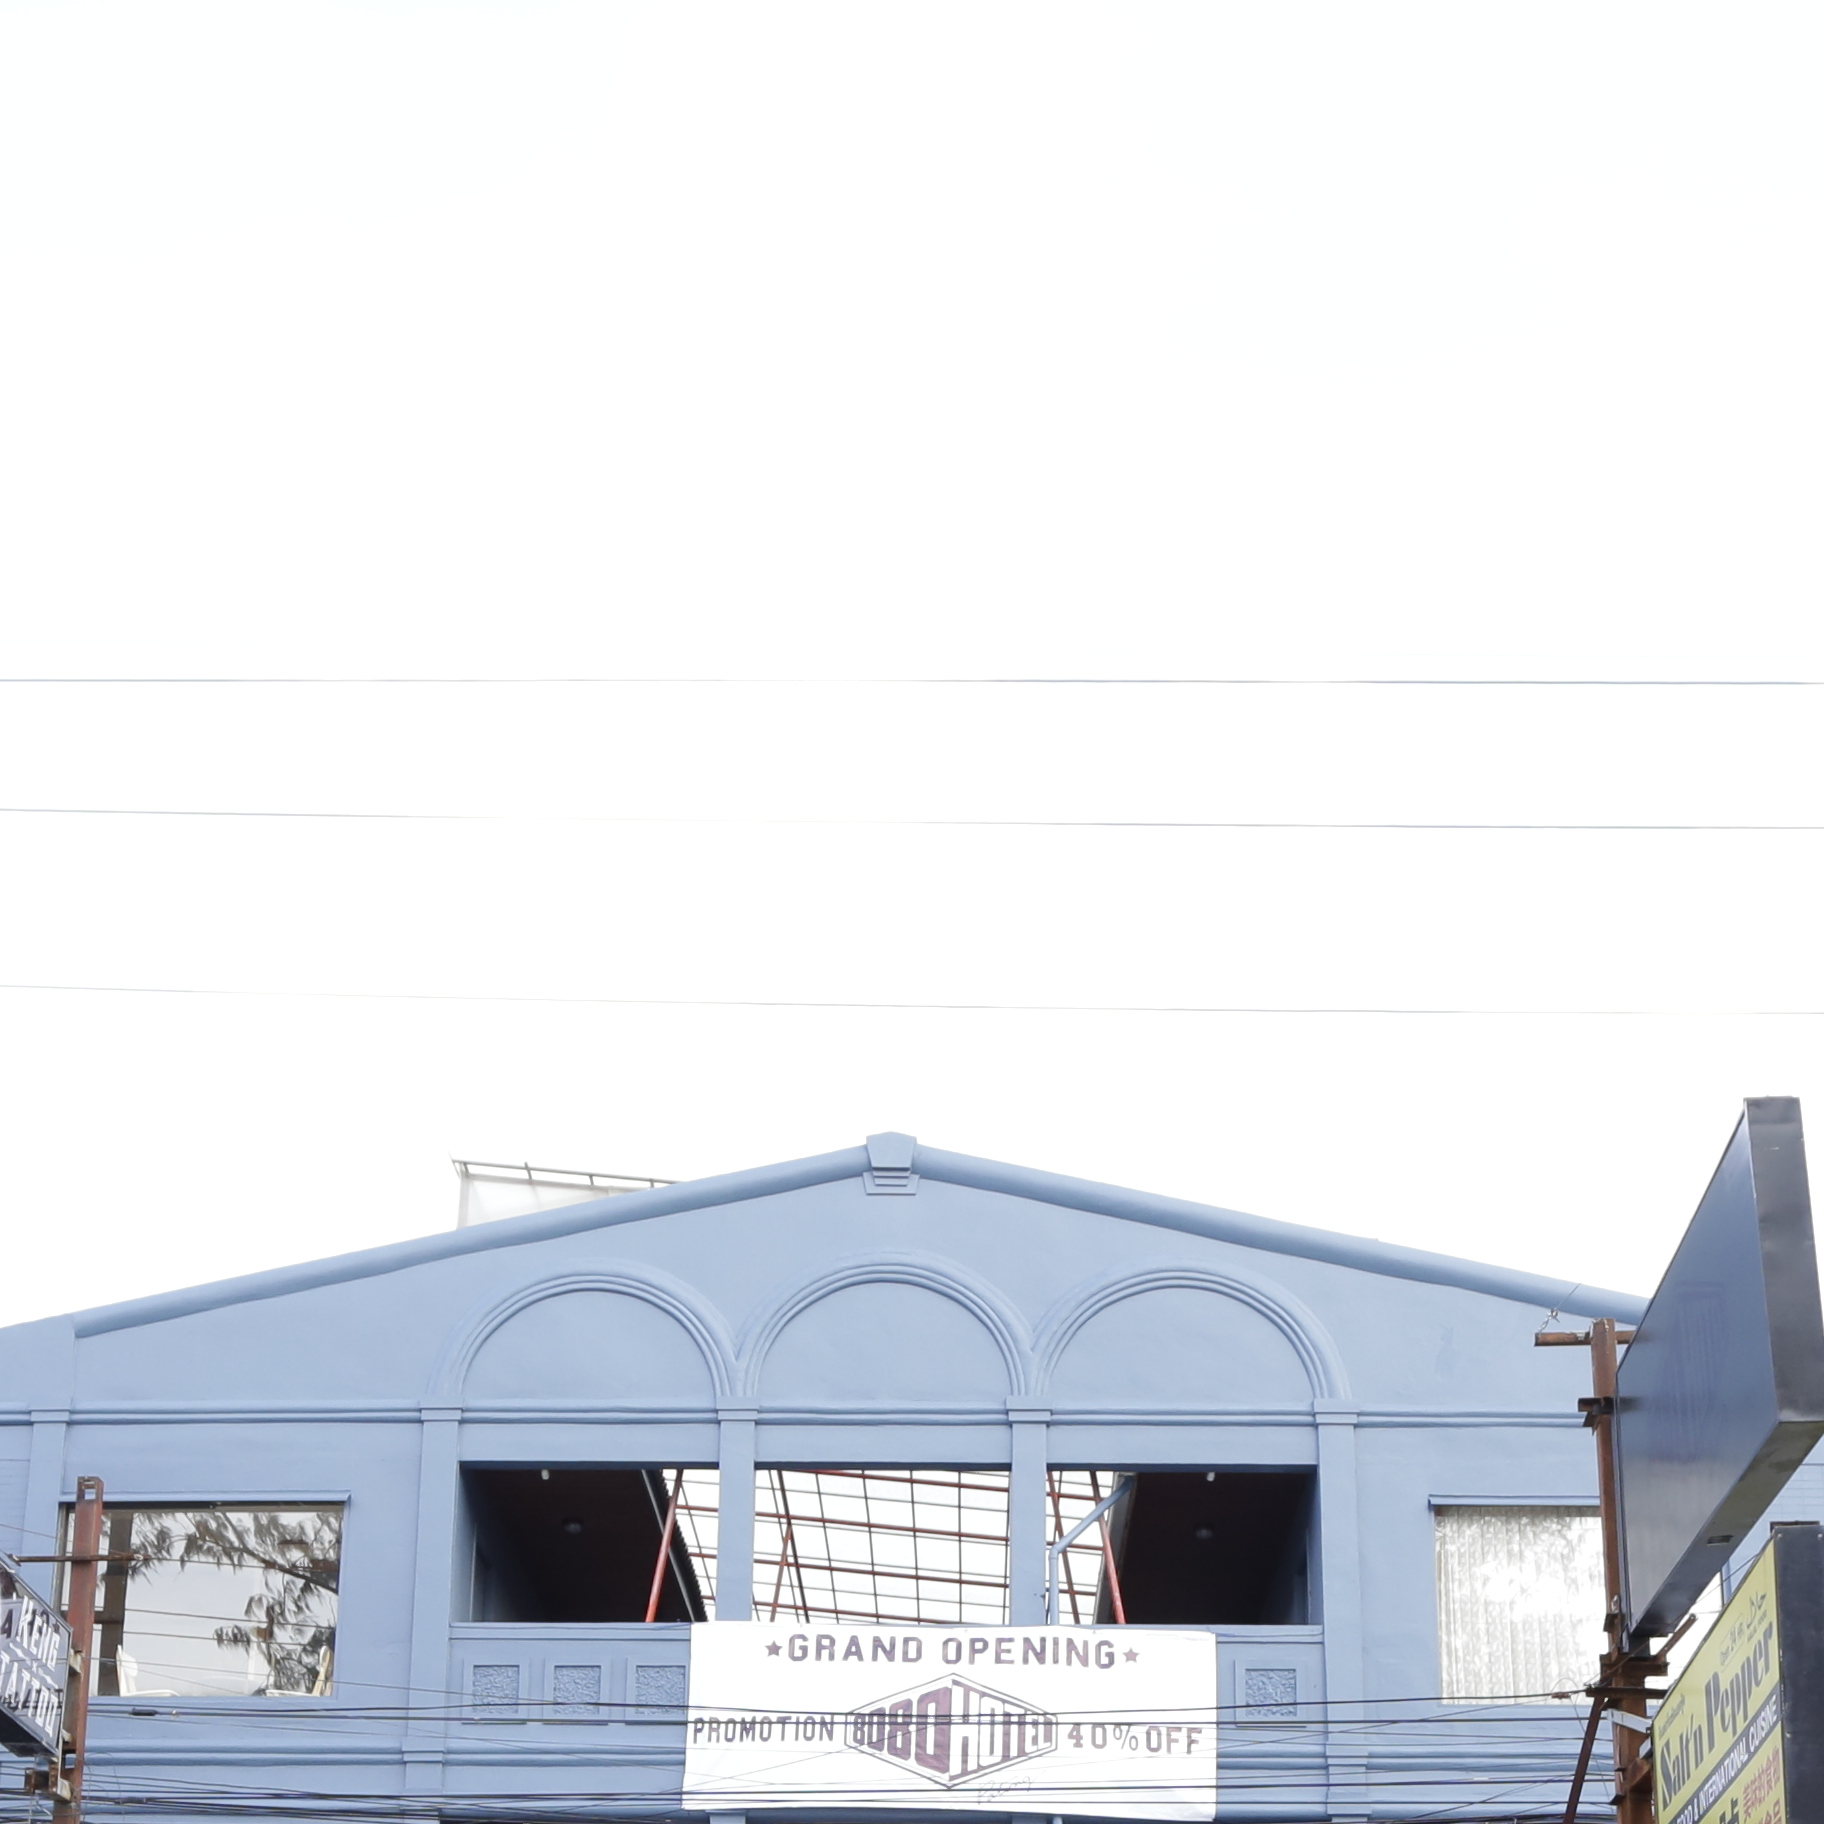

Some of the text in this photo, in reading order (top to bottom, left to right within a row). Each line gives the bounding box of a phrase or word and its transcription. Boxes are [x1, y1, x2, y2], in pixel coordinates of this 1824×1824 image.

[787, 1633, 1116, 1670] GRAND OPENING
[1705, 1621, 1774, 1755] Pepper
[692, 1714, 835, 1745] PROMOTION
[1699, 1741, 1748, 1819] INTERNATIONAL
[1748, 1692, 1777, 1758] CUISINE
